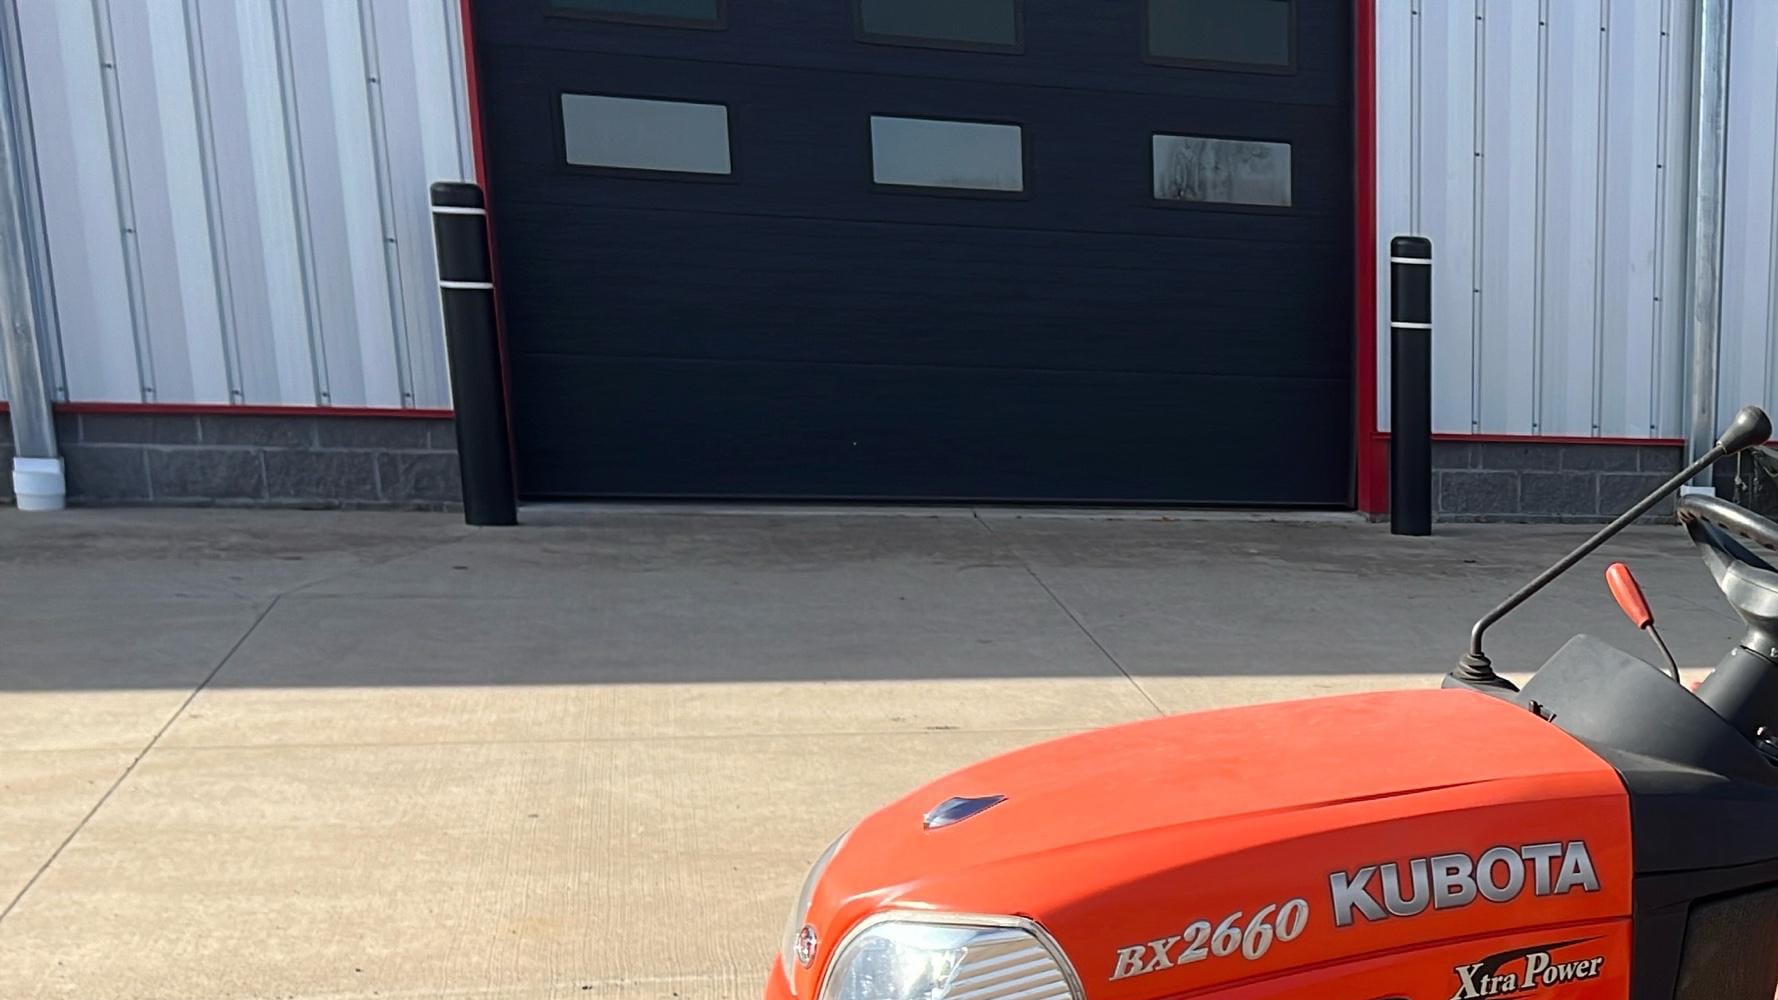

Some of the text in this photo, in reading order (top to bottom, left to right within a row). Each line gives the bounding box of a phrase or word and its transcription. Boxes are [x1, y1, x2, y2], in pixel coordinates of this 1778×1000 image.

[1329, 841, 1601, 927] KUBOTA
[1109, 898, 1310, 982] BX2660
[1520, 950, 1604, 989] Power
